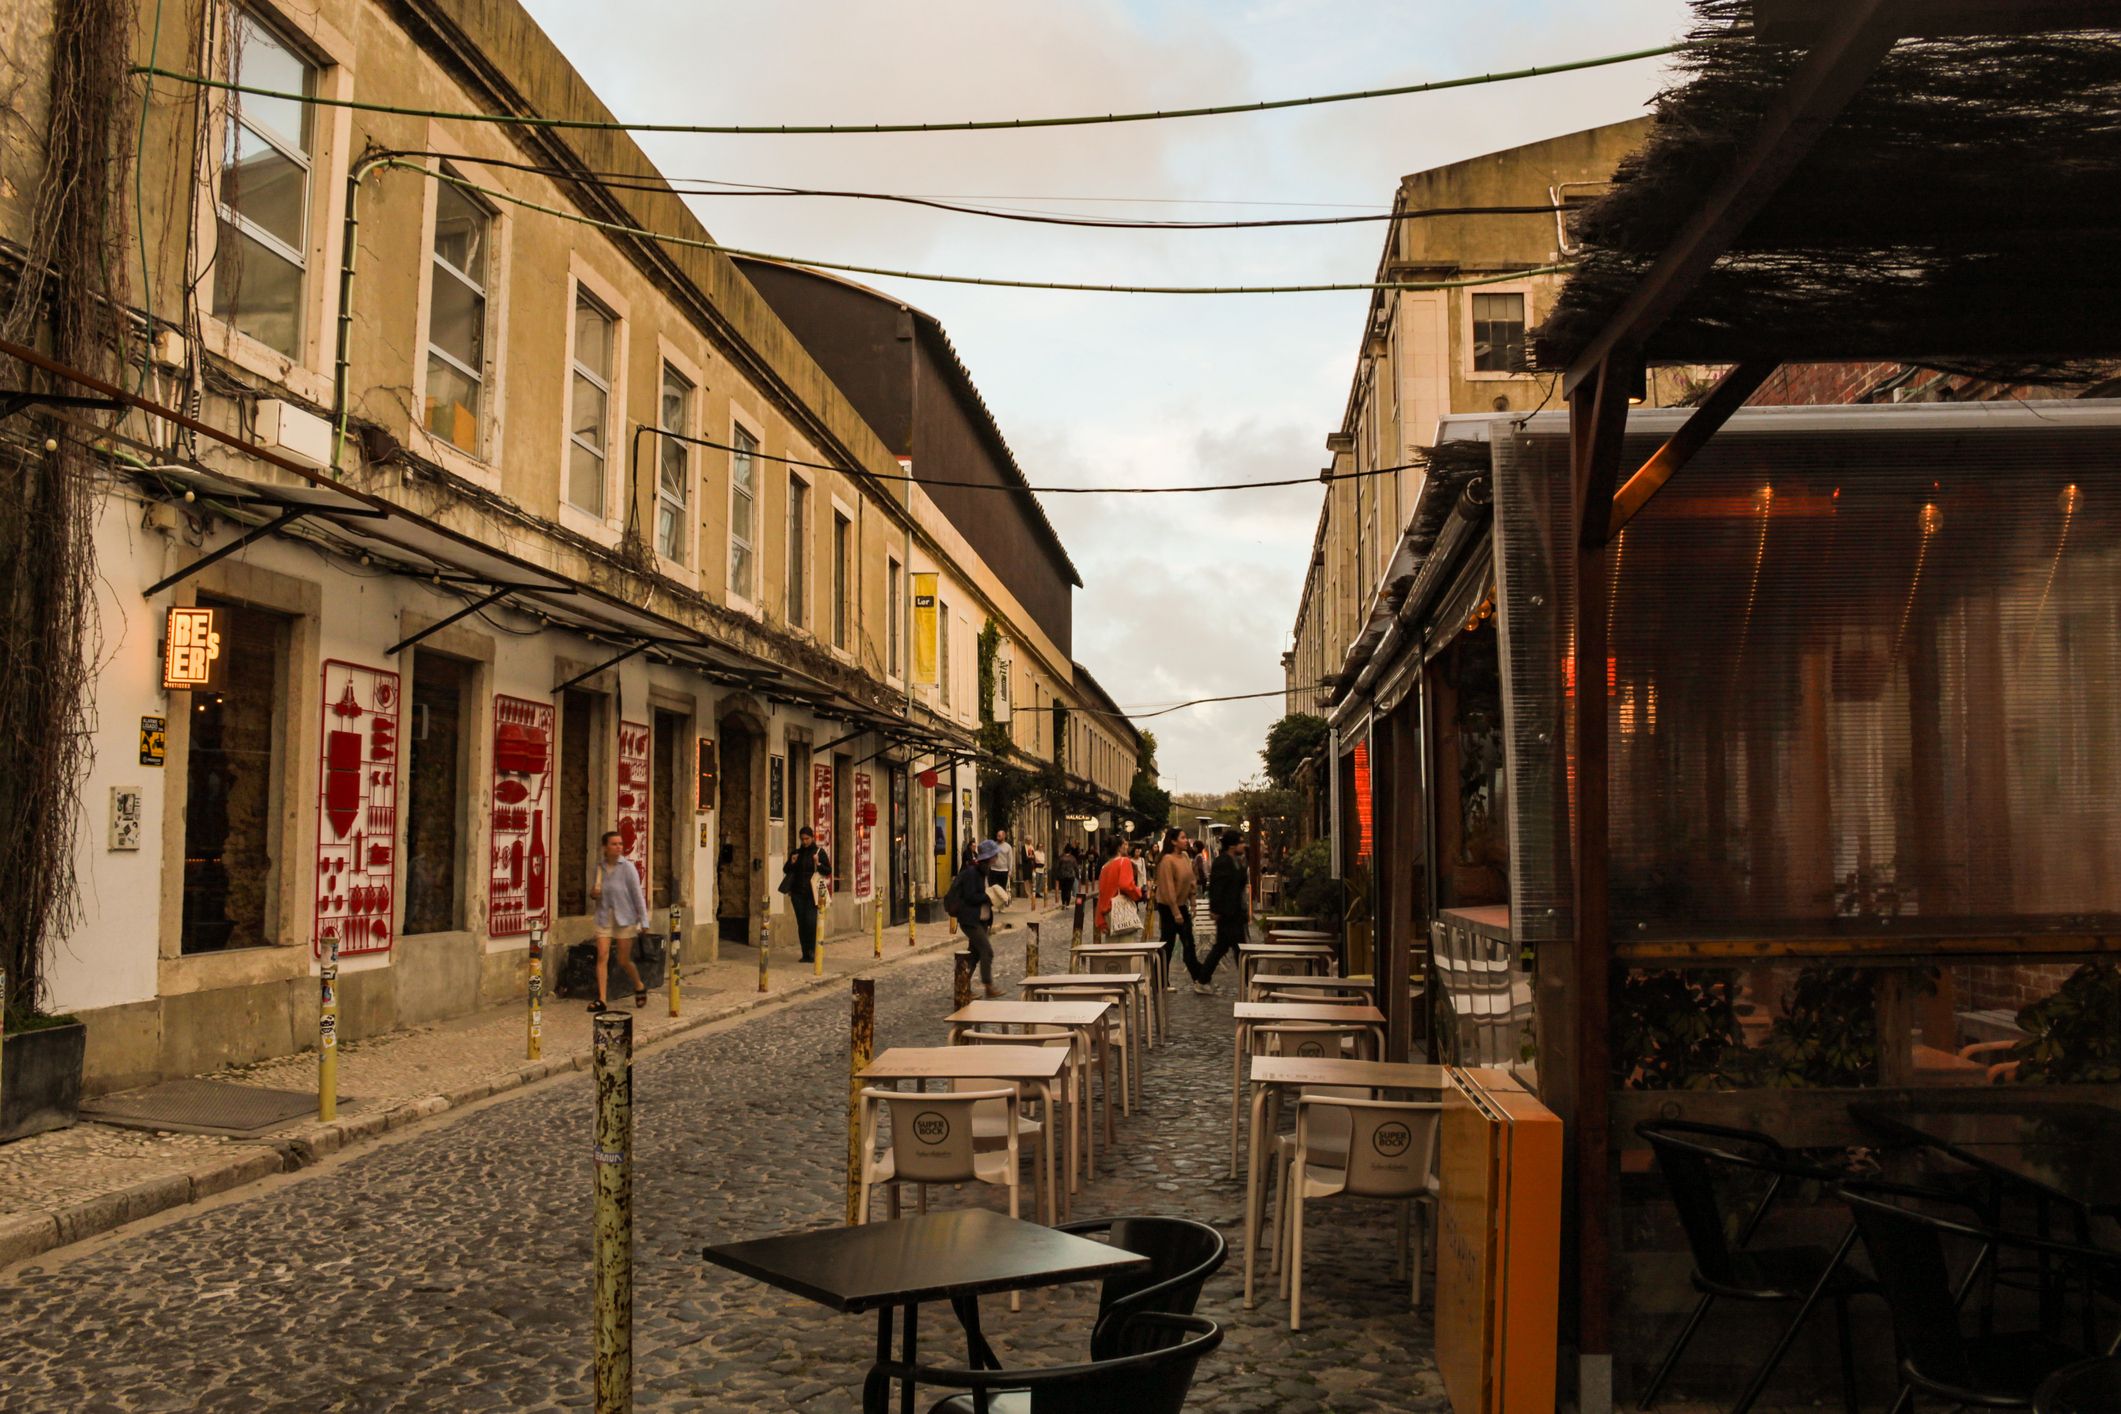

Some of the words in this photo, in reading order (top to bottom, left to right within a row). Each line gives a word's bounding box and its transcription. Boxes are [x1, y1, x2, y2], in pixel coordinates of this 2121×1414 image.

[917, 1120, 944, 1128] SUPER
[919, 1127, 943, 1135] BOCK
[1379, 1131, 1407, 1139] SUPER
[1379, 1139, 1404, 1147] BOCK
